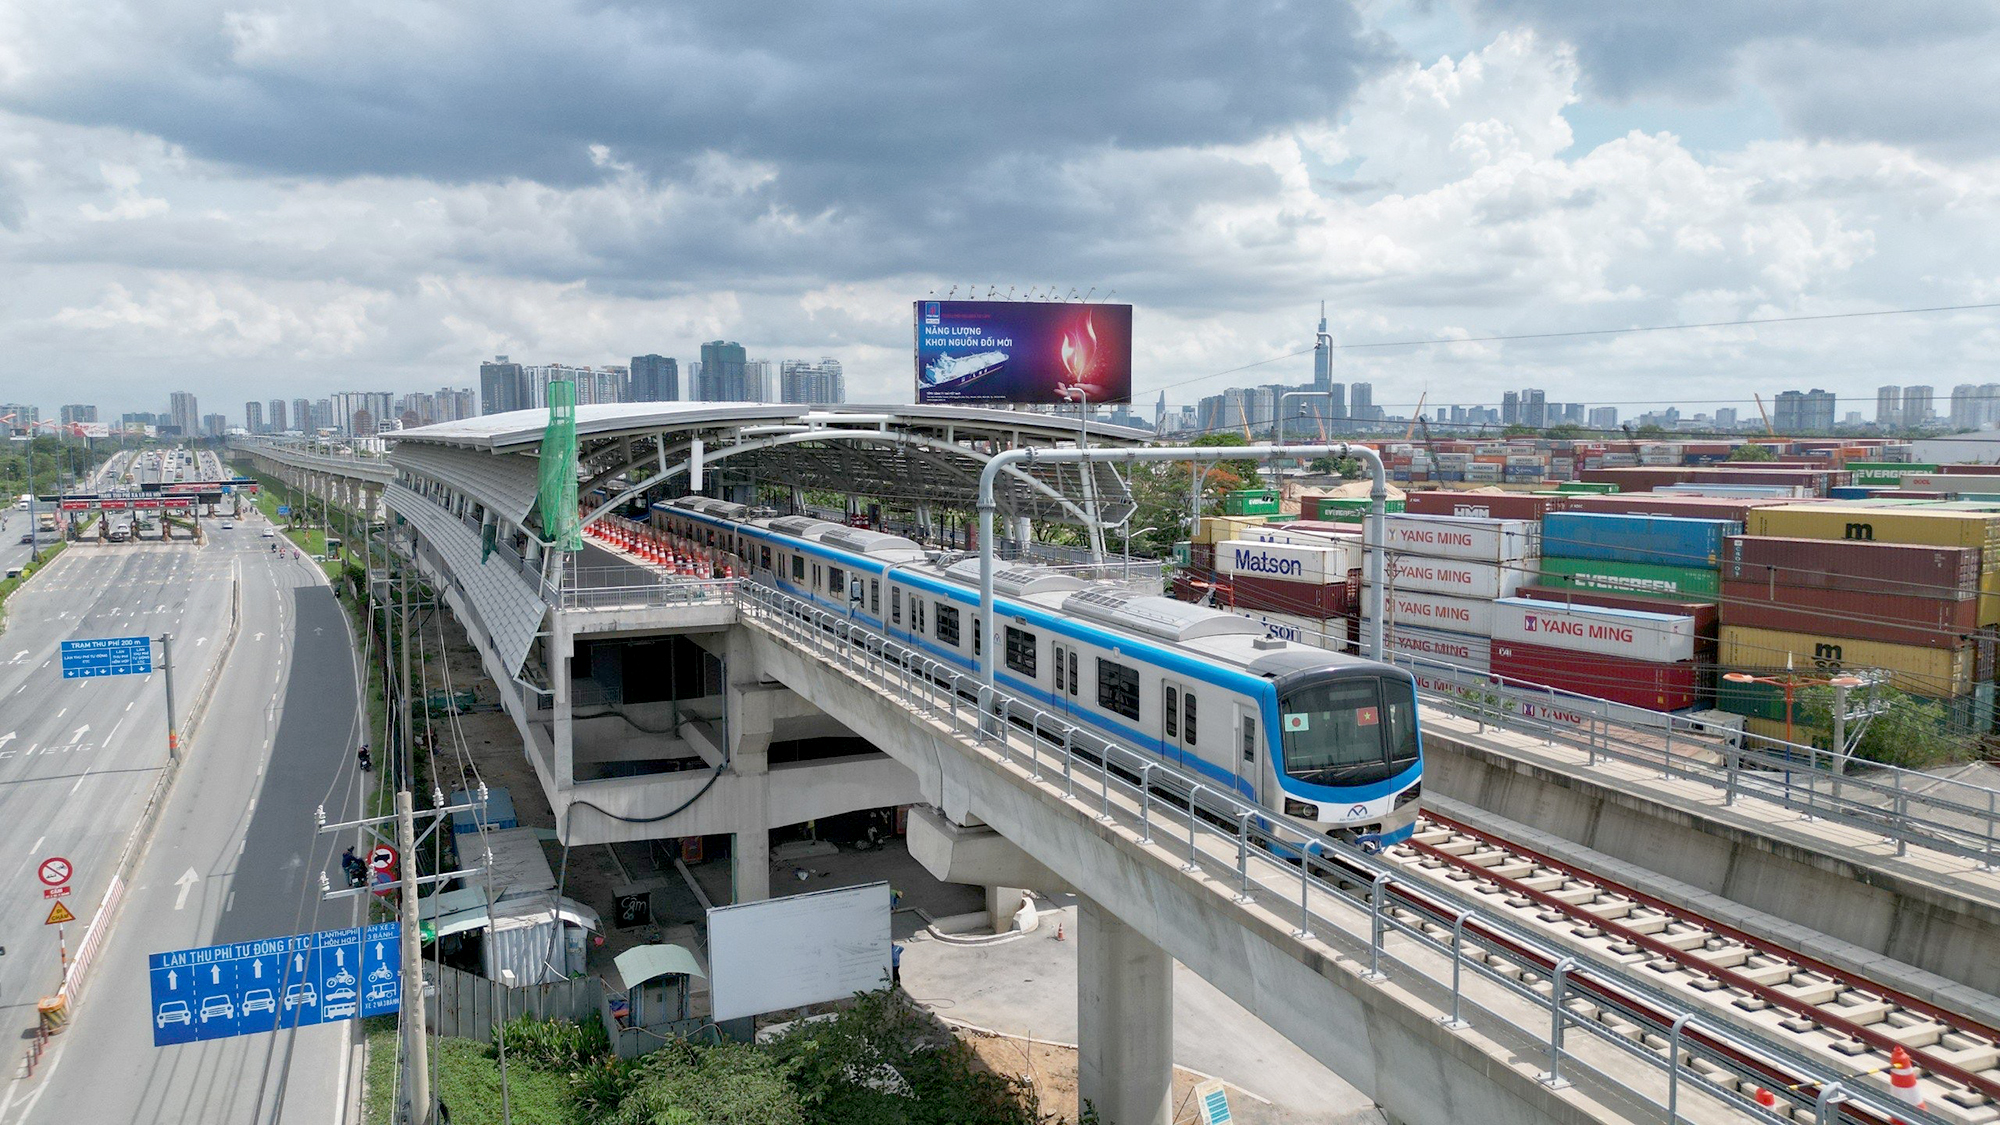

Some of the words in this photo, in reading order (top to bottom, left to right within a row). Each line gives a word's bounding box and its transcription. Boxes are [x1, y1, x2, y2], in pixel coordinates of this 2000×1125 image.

[925, 325, 950, 335] NĂNG
[951, 326, 982, 337] LƯỢNG
[925, 338, 947, 347] KHƠI
[996, 337, 1013, 347] MỚI
[1400, 529, 1433, 543] YANG
[1437, 532, 1472, 546] MING
[1235, 549, 1302, 576] Matson
[1400, 565, 1433, 580] YANG
[1437, 569, 1472, 584] MING
[1575, 572, 1677, 594] EVERGREEN
[1398, 601, 1431, 616] YANG
[1435, 605, 1470, 621] MING
[1541, 619, 1583, 637] YANG
[1588, 624, 1633, 643] MING
[1398, 637, 1431, 652] YANG
[1434, 642, 1469, 658] MING
[1498, 648, 1512, 658] CAI
[1414, 675, 1430, 688] NG
[163, 949, 187, 967] LÀN
[190, 950, 212, 964] THU
[214, 944, 232, 960] PHÍ
[235, 945, 251, 958] TỰ
[253, 939, 285, 955] ĐỘNG
